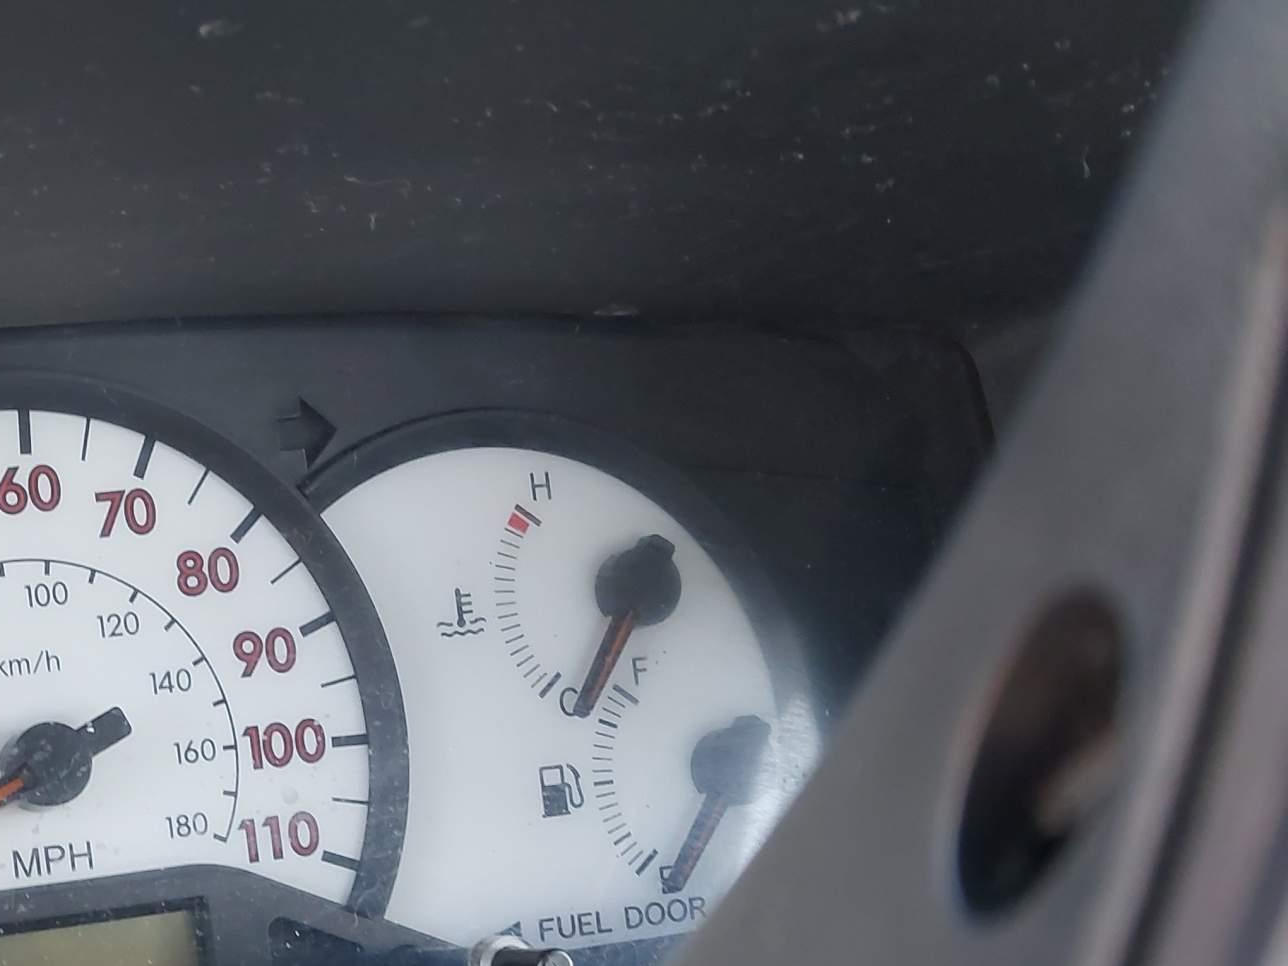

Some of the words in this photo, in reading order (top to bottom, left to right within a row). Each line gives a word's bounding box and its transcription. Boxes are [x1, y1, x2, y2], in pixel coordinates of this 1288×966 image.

[529, 471, 552, 502] H
[95, 488, 156, 538] 70
[176, 547, 239, 596] 80
[25, 582, 69, 608] 100
[97, 612, 140, 638] 120
[233, 627, 296, 677] 90
[149, 669, 192, 695] 140
[632, 656, 648, 685] F
[173, 738, 216, 765] 160
[243, 718, 326, 770] 100
[166, 812, 208, 839] 180
[238, 811, 320, 863] 110
[12, 841, 94, 880] MPH
[538, 911, 613, 942] FUEL
[624, 897, 707, 929] DOOR
